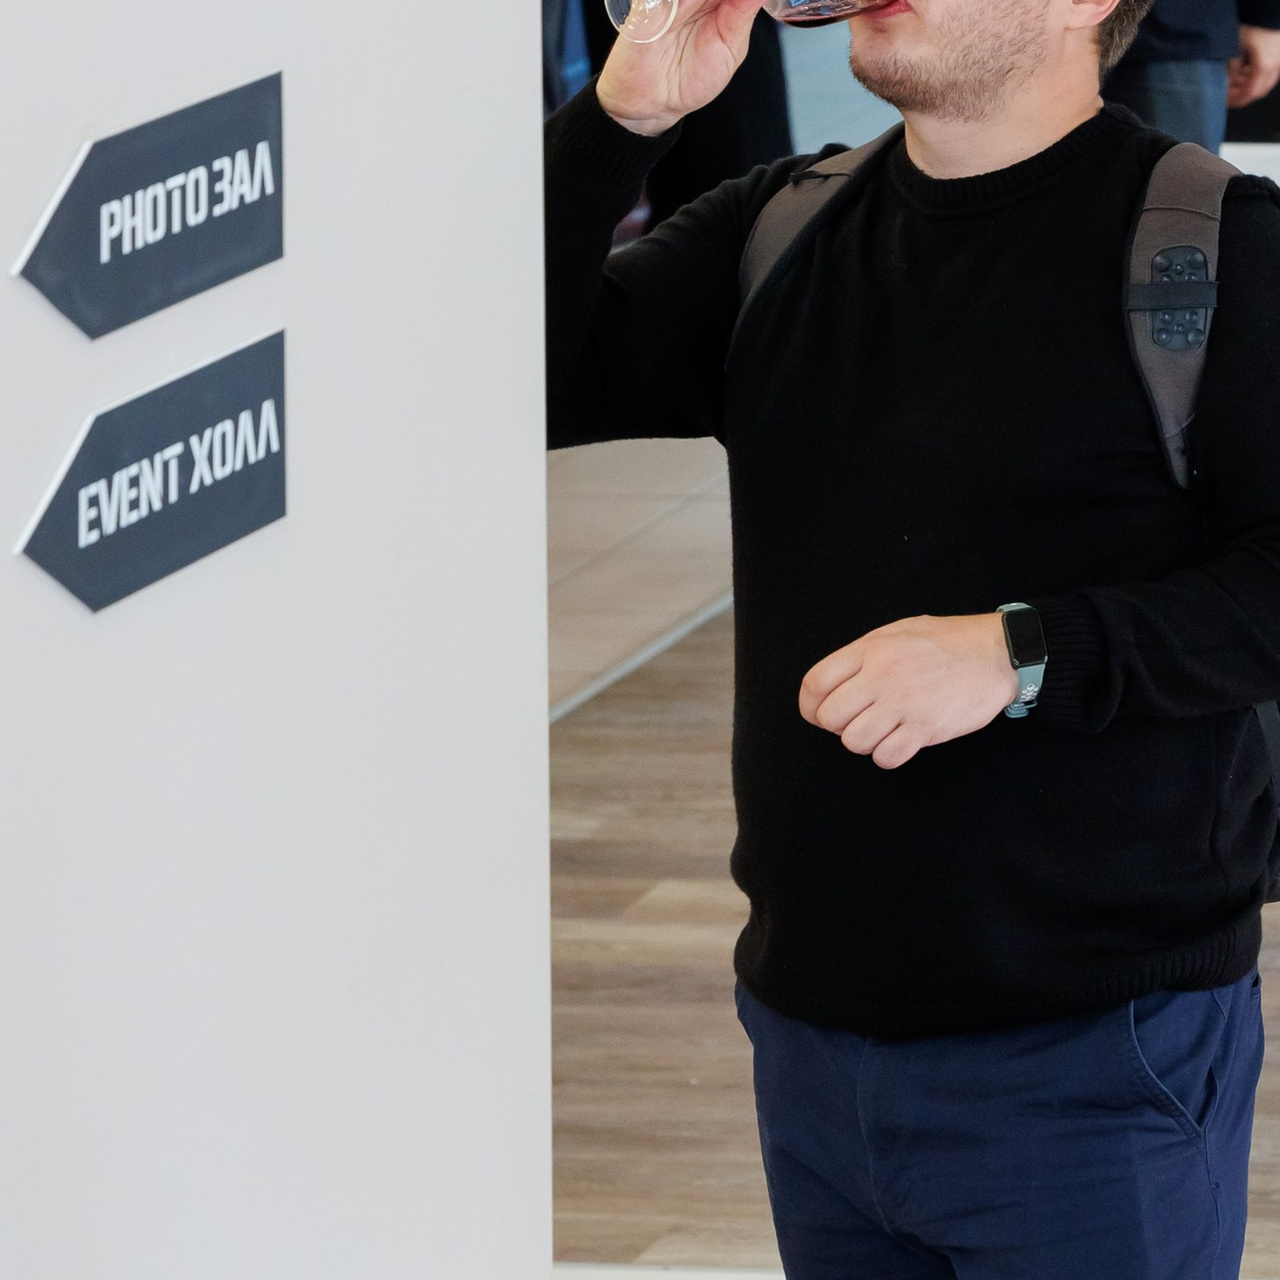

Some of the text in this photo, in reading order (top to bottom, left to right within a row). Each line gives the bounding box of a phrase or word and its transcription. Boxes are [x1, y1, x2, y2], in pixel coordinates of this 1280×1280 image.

[99, 140, 274, 265] PHOTO ЗАЛ
[77, 398, 280, 549] EVENT ХОЛЛ
